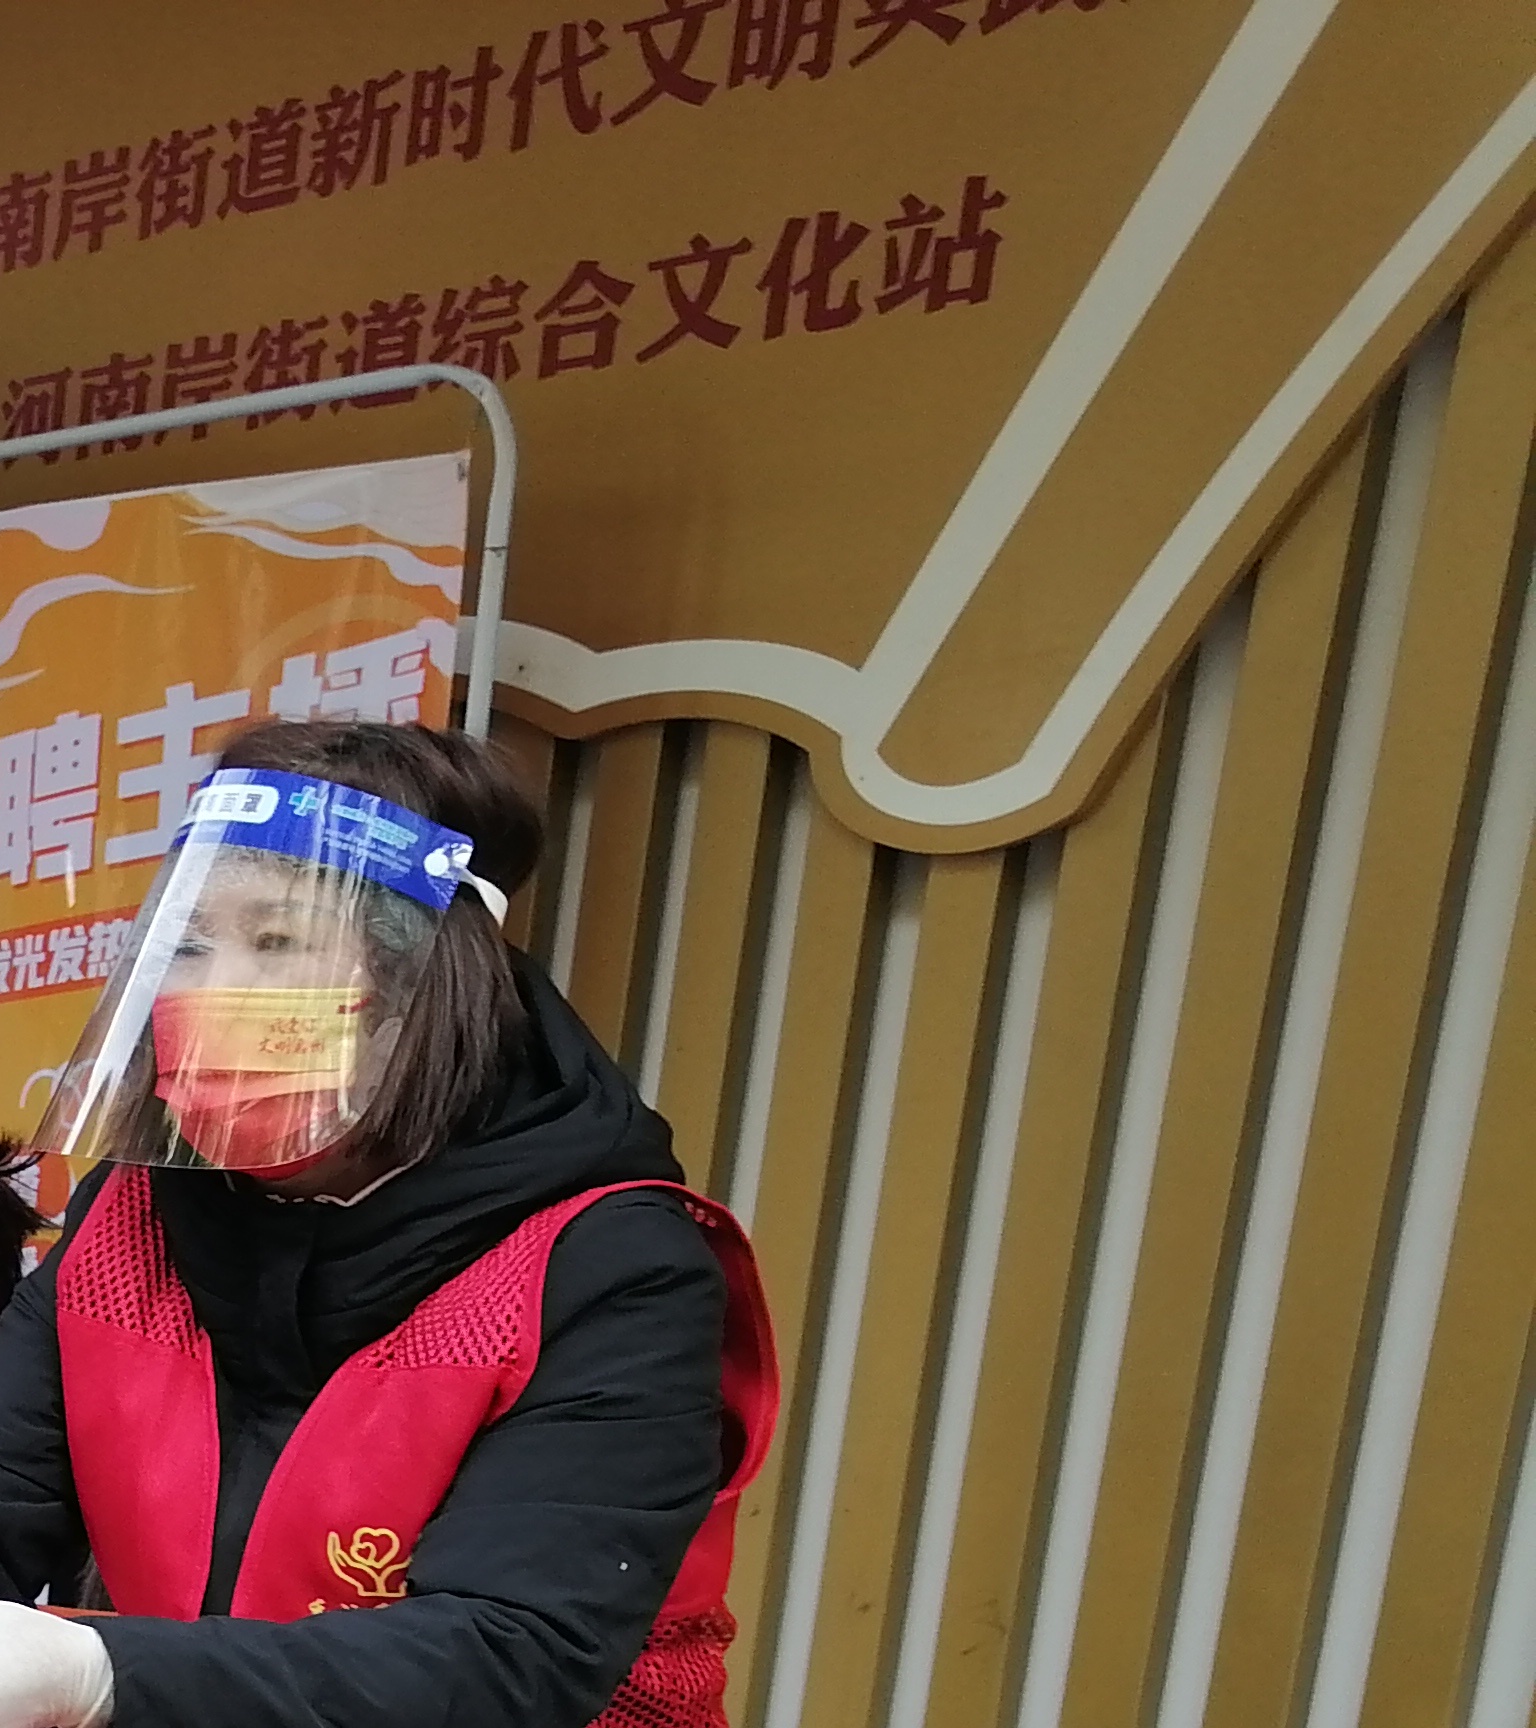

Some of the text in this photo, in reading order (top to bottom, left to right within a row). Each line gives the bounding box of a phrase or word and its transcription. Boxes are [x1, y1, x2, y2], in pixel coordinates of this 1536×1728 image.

[0, 175, 1008, 470] 河南岸街道综合文化站
